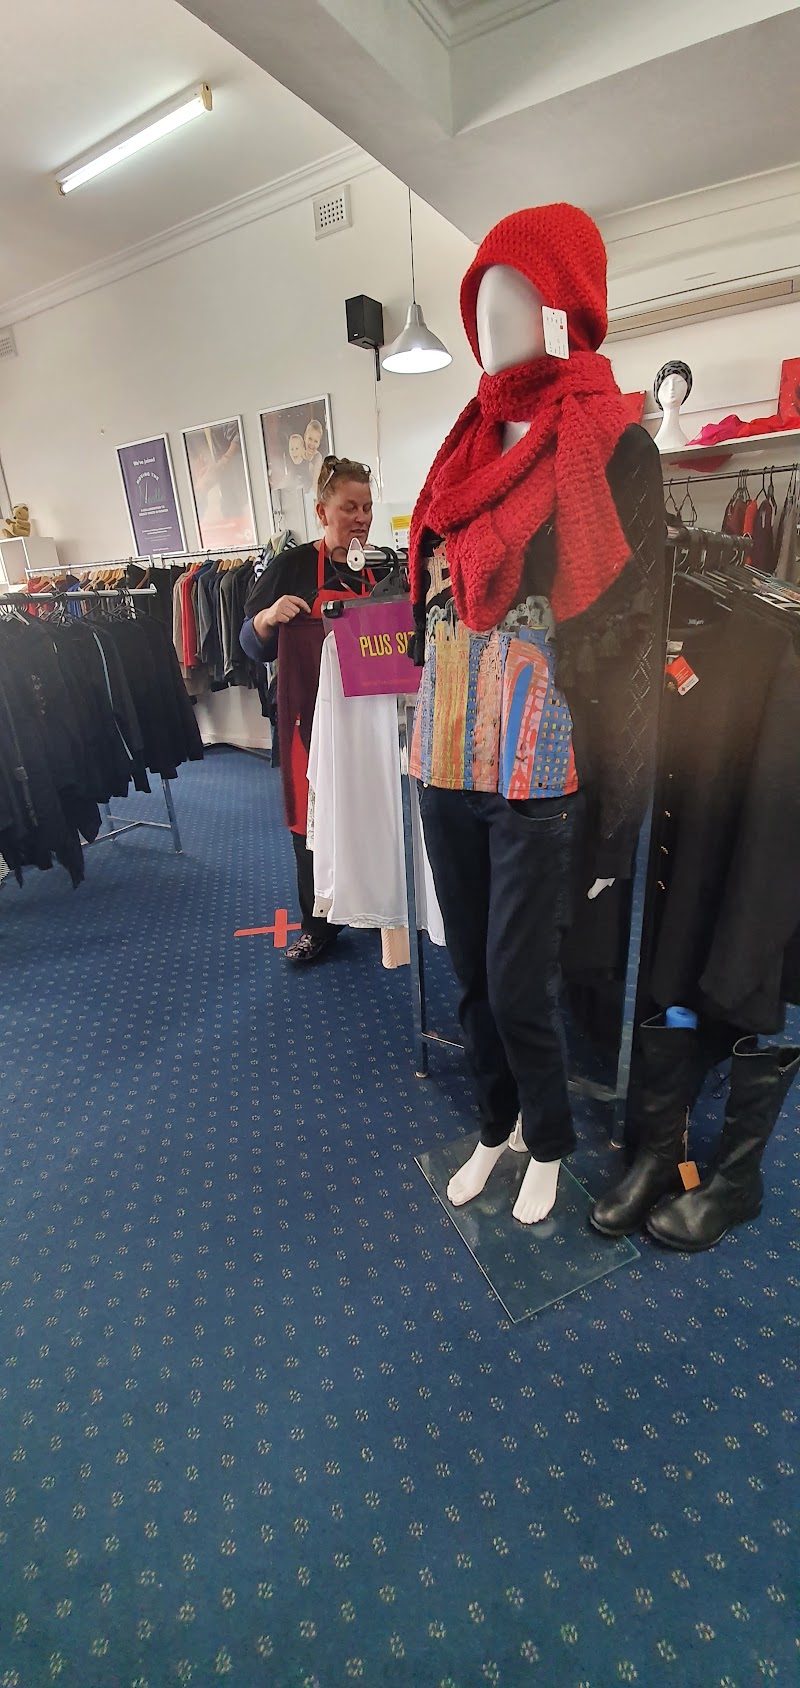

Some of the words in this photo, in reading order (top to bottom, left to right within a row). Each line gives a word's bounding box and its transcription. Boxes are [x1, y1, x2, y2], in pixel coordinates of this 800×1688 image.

[136, 472, 150, 484] MOVING
[151, 472, 159, 481] THE
[359, 634, 393, 657] PLUS
